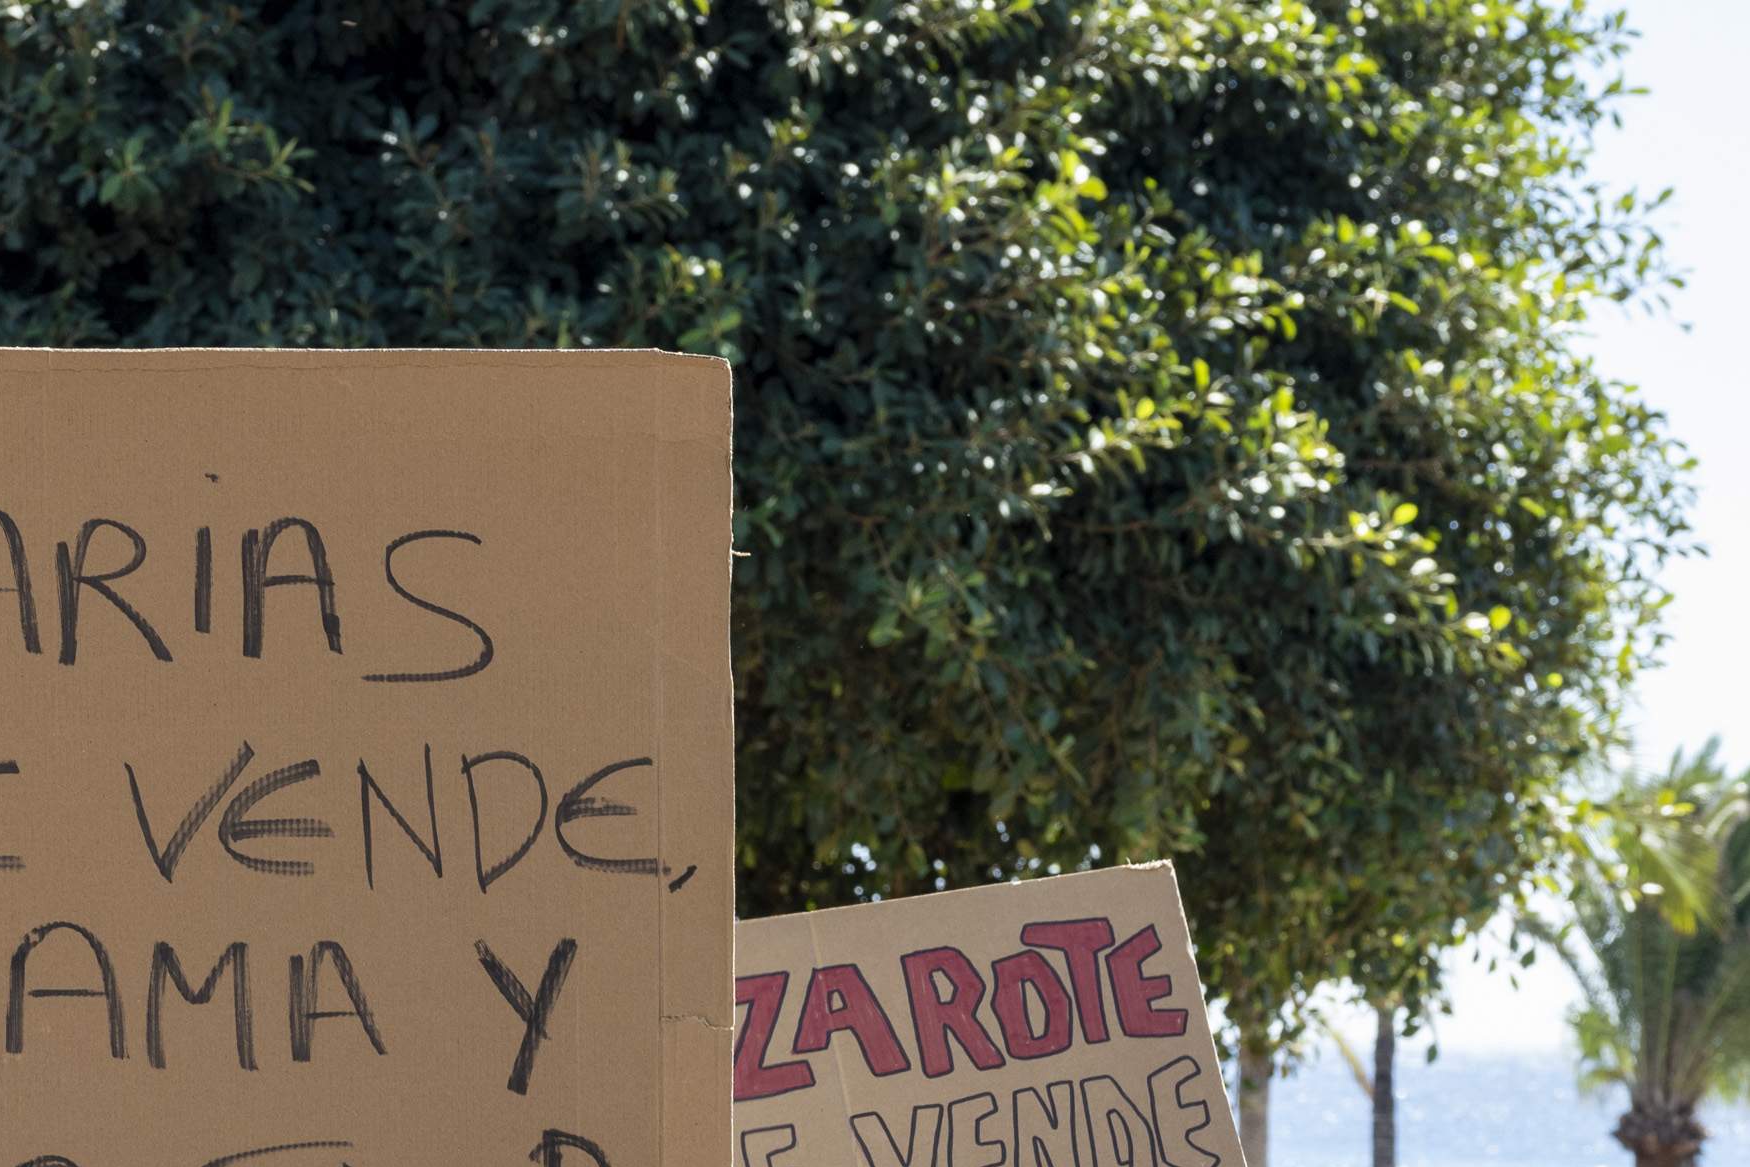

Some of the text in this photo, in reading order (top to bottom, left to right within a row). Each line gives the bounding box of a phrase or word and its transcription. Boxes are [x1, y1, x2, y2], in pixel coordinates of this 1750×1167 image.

[124, 739, 698, 894] VENDE,
[5, 921, 388, 1071] AMA
[473, 938, 577, 1096] Y
[734, 917, 1188, 1100] ZAROTE
